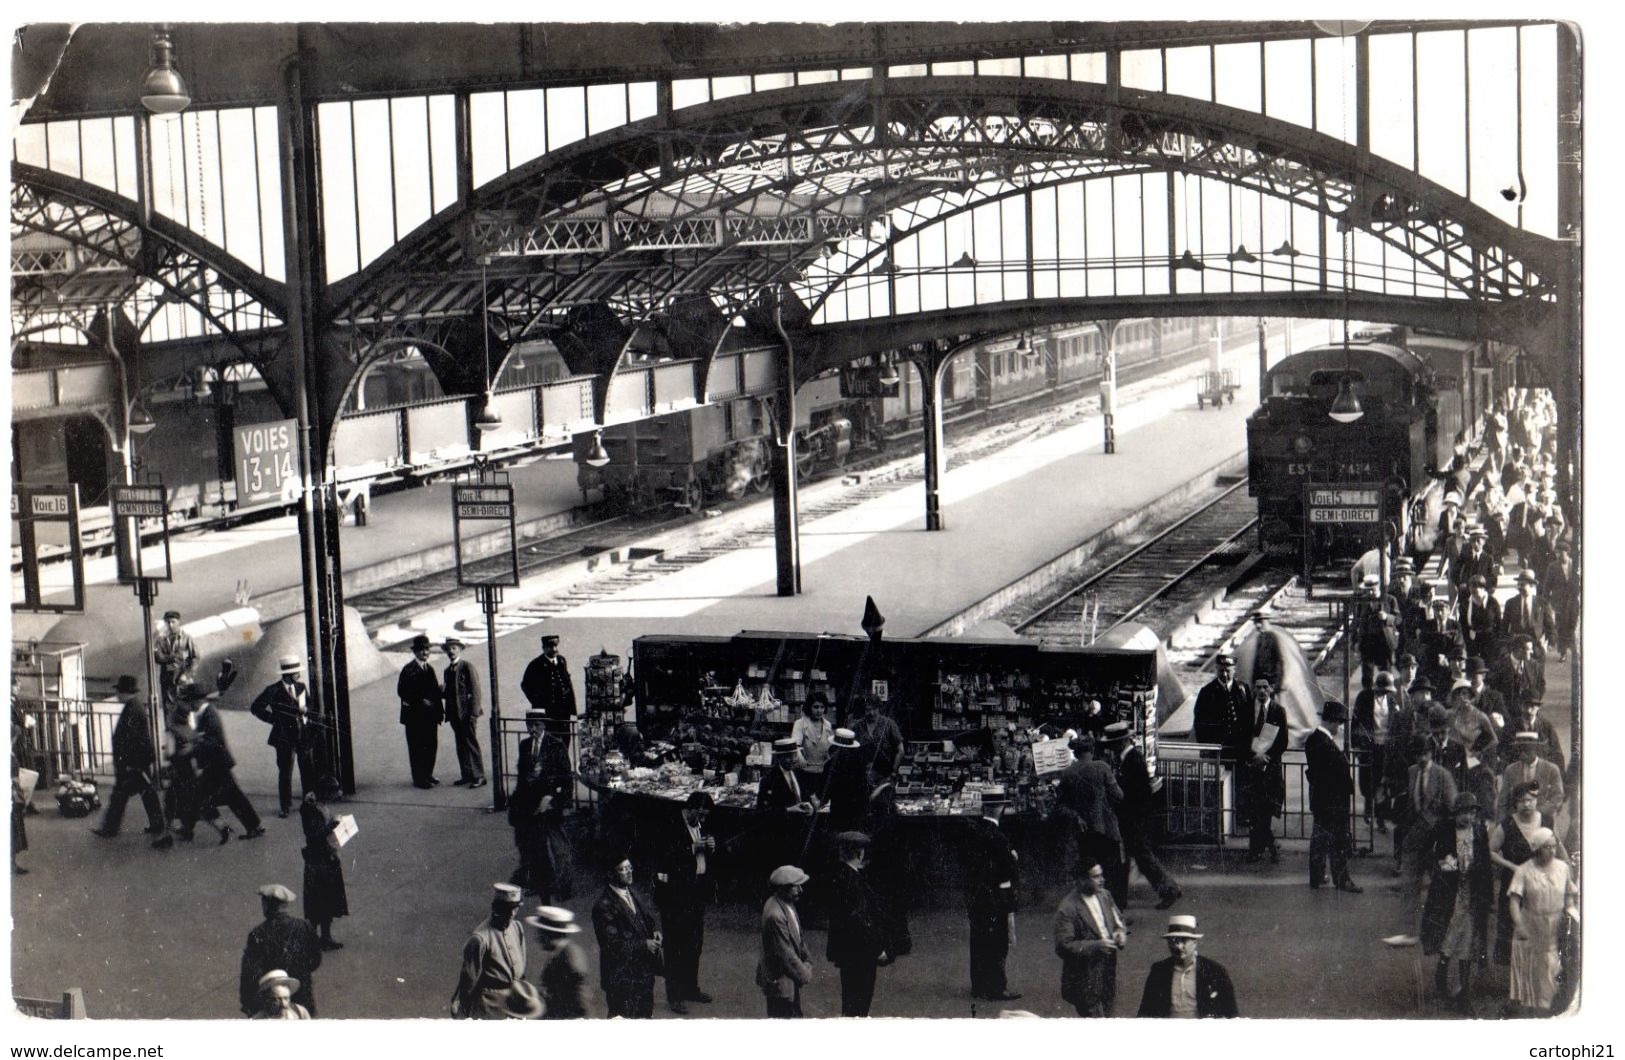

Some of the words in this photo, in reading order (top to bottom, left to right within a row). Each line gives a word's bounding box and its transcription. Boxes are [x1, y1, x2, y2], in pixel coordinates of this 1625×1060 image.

[241, 426, 289, 454] VOIES
[243, 452, 294, 494] 13-14
[1289, 464, 1313, 475] EST
[1332, 490, 1342, 504] 15
[55, 497, 66, 512] 16
[120, 503, 160, 514] OMNIBUS
[461, 505, 507, 516] SEMI-DIRECT
[1315, 509, 1376, 521] SEMI-DIRECT
[875, 685, 885, 695] 18
